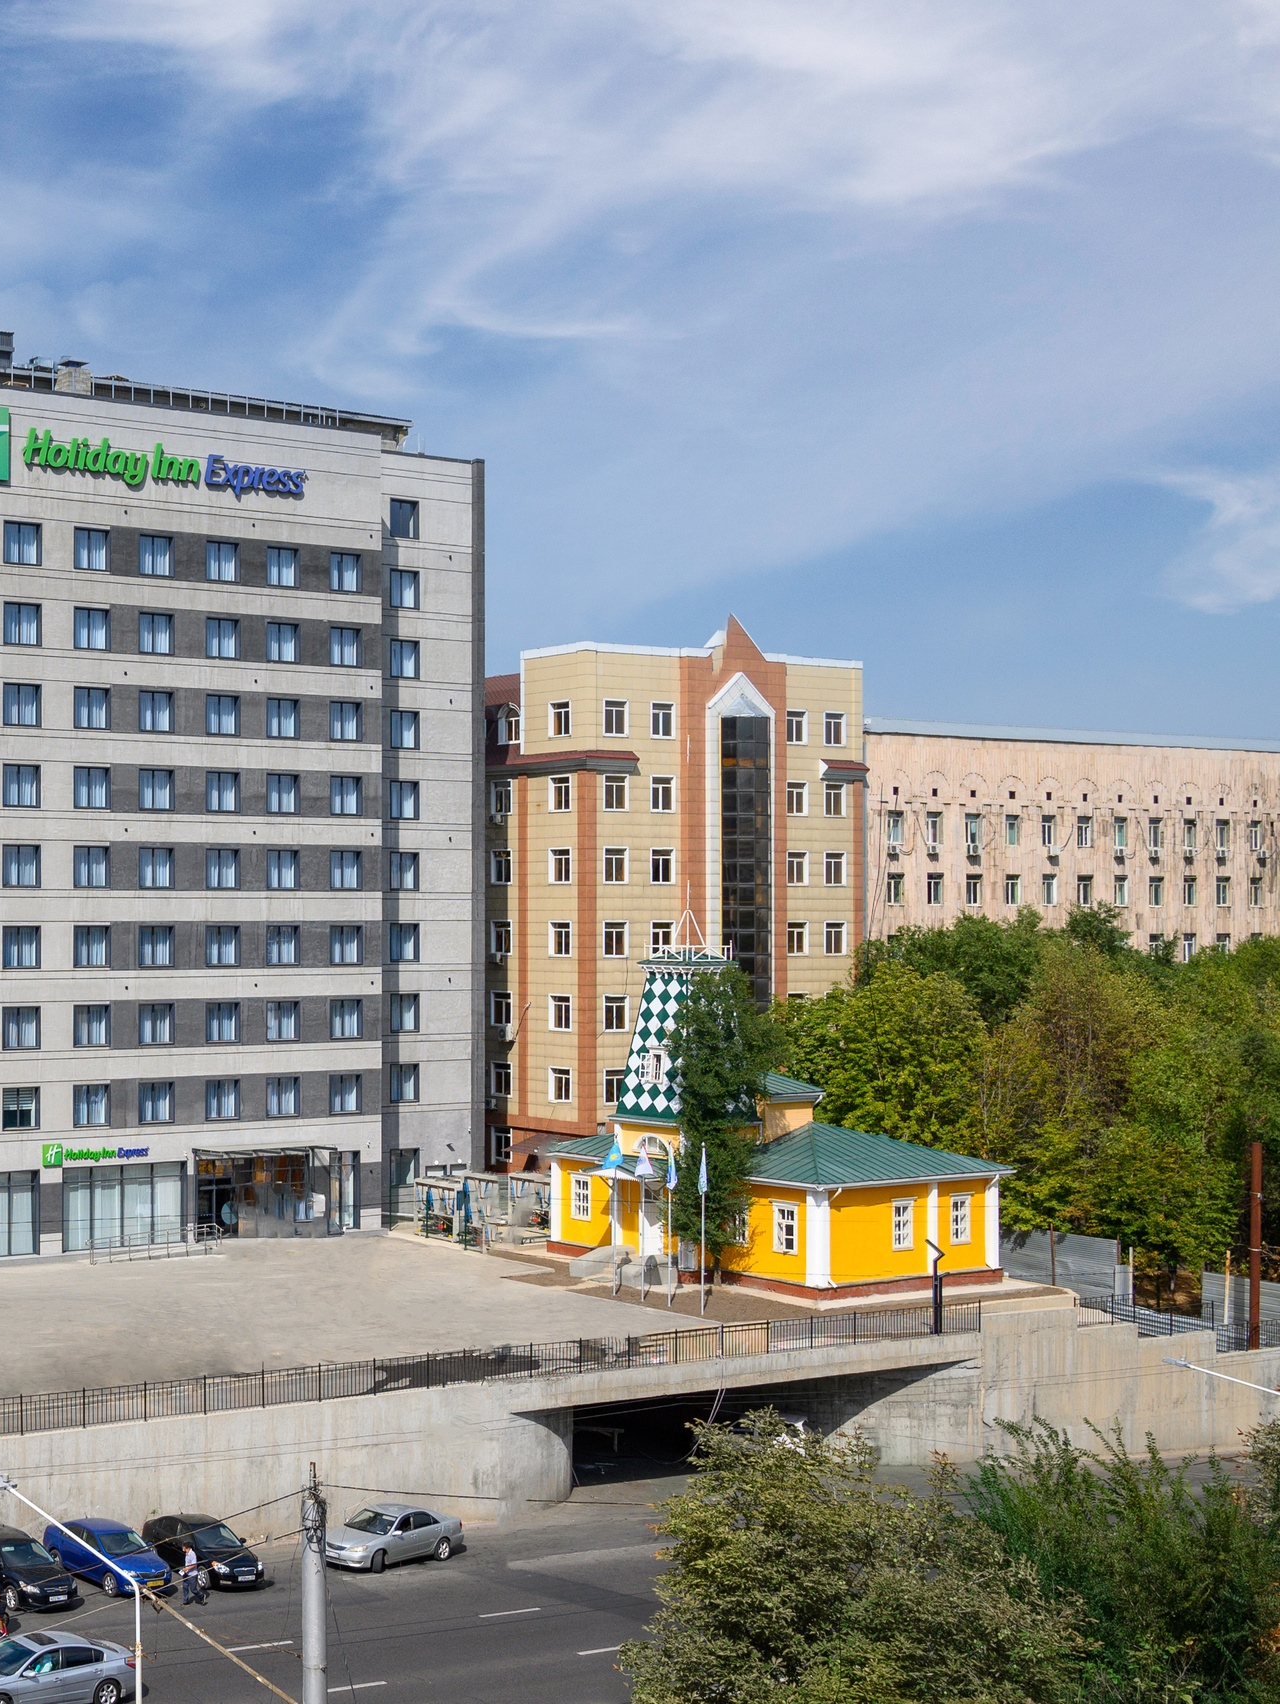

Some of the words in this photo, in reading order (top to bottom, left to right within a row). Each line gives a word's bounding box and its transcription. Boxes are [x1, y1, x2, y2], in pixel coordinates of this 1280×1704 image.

[22, 427, 148, 485] Holiday
[151, 442, 200, 483] Inn
[204, 453, 305, 495] Express
[64, 1147, 101, 1161] Holiday
[101, 1146, 116, 1158] Inn
[117, 1147, 149, 1160] Express
